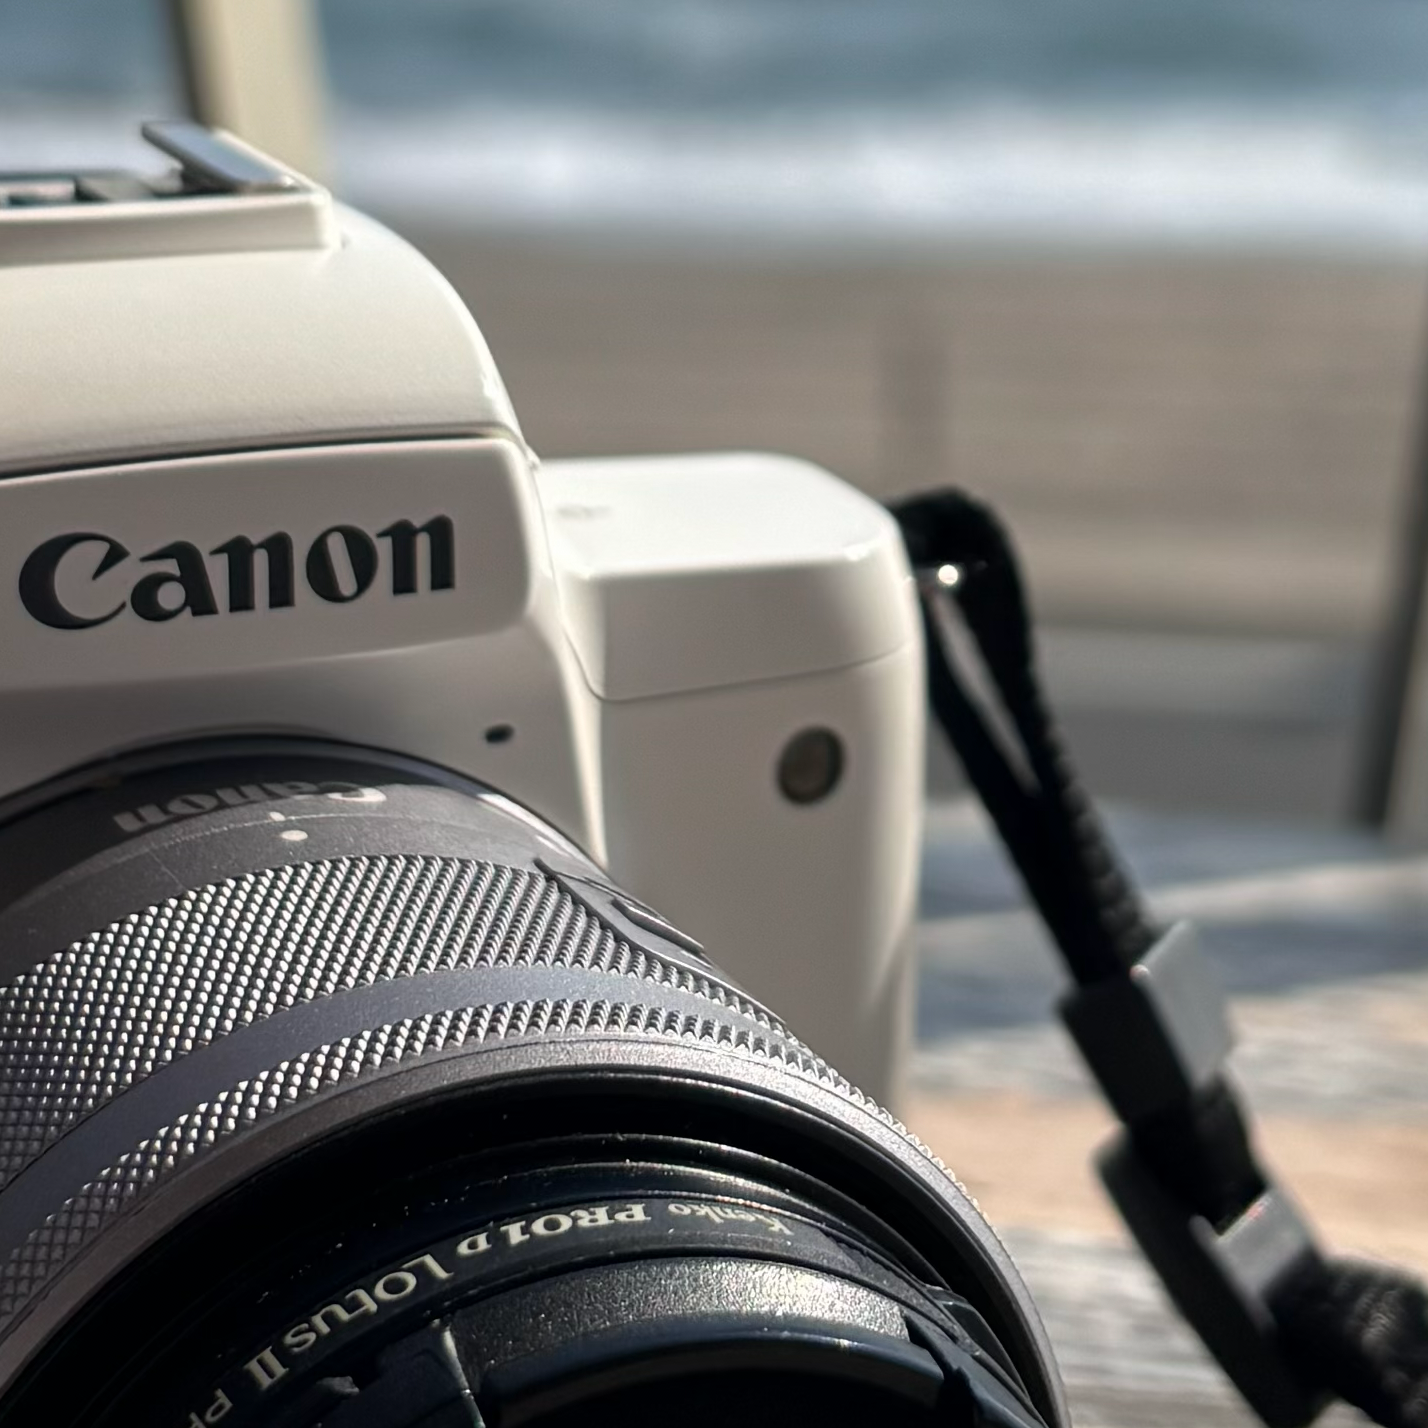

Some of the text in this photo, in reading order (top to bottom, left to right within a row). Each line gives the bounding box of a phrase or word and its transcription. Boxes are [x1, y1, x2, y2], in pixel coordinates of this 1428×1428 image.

[18, 514, 456, 630] Canon
[113, 781, 387, 832] Canon
[667, 1203, 794, 1236] Kenko
